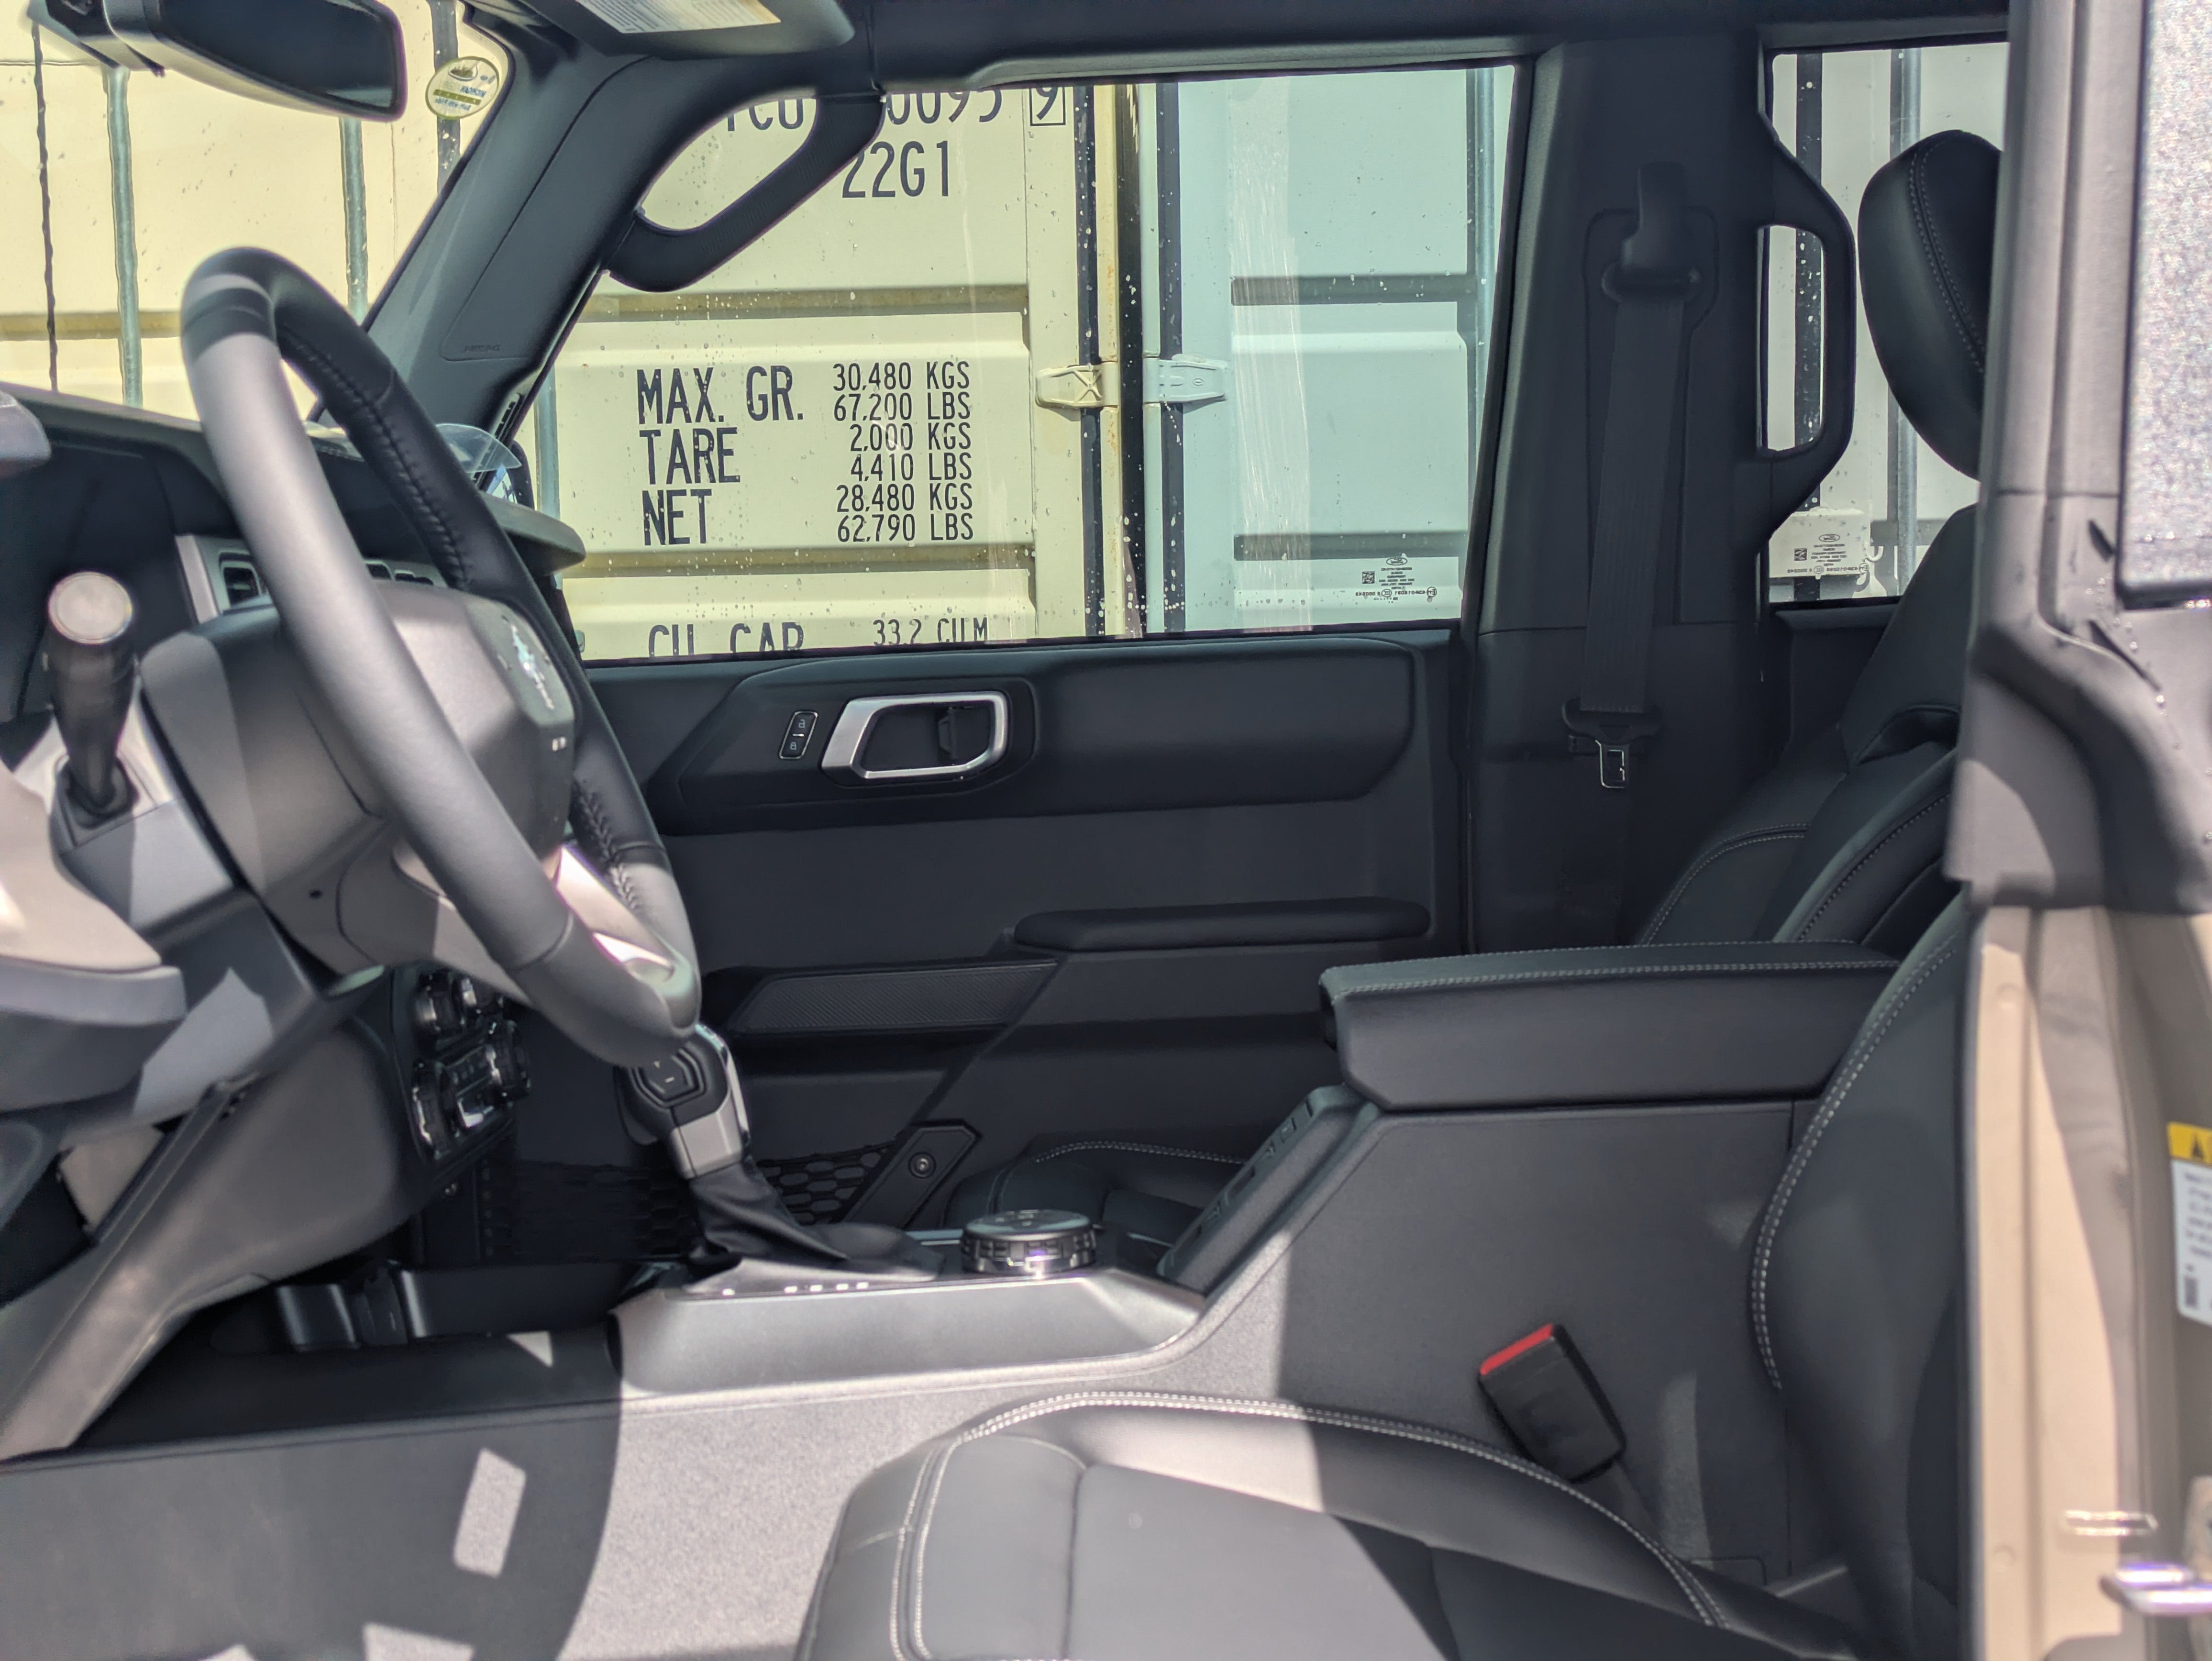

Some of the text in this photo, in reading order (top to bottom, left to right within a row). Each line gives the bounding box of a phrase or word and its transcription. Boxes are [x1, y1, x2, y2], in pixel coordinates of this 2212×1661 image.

[842, 140, 949, 198] 22G1
[637, 367, 724, 424] MAX.
[746, 365, 804, 421] GR.
[926, 361, 970, 389] KGS
[927, 391, 971, 420] LBS
[639, 427, 741, 485] TARE
[928, 421, 972, 450] KGS
[928, 452, 972, 481] LBS
[642, 488, 712, 546] NET
[929, 482, 973, 511] KGS
[930, 512, 974, 541] LBS
